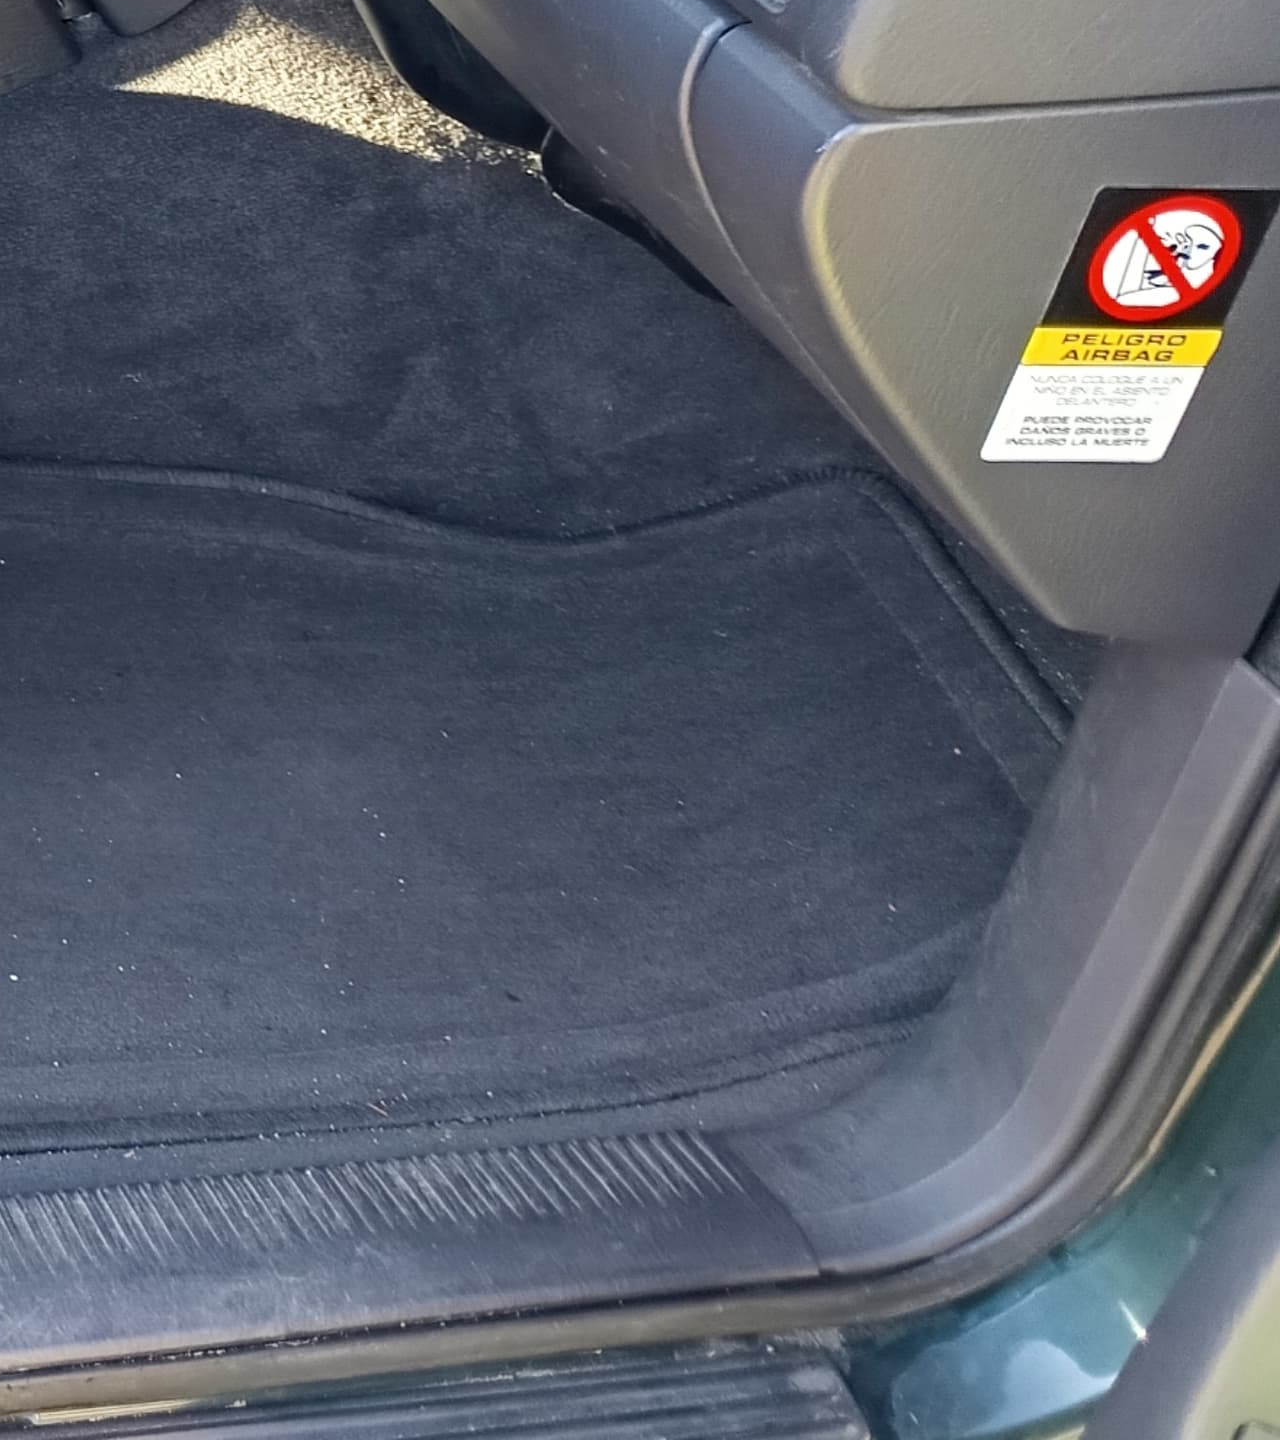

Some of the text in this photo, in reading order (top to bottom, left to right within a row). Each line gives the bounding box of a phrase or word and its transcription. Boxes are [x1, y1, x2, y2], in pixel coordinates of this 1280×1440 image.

[1062, 333, 1187, 346] PELIGRO
[1060, 350, 1175, 361] AIRBAG
[1023, 416, 1153, 425] PUEDE PROVOCAR
[1074, 427, 1132, 436] GRAVES
[1005, 437, 1151, 447] INCLUSO LA MUERTE
